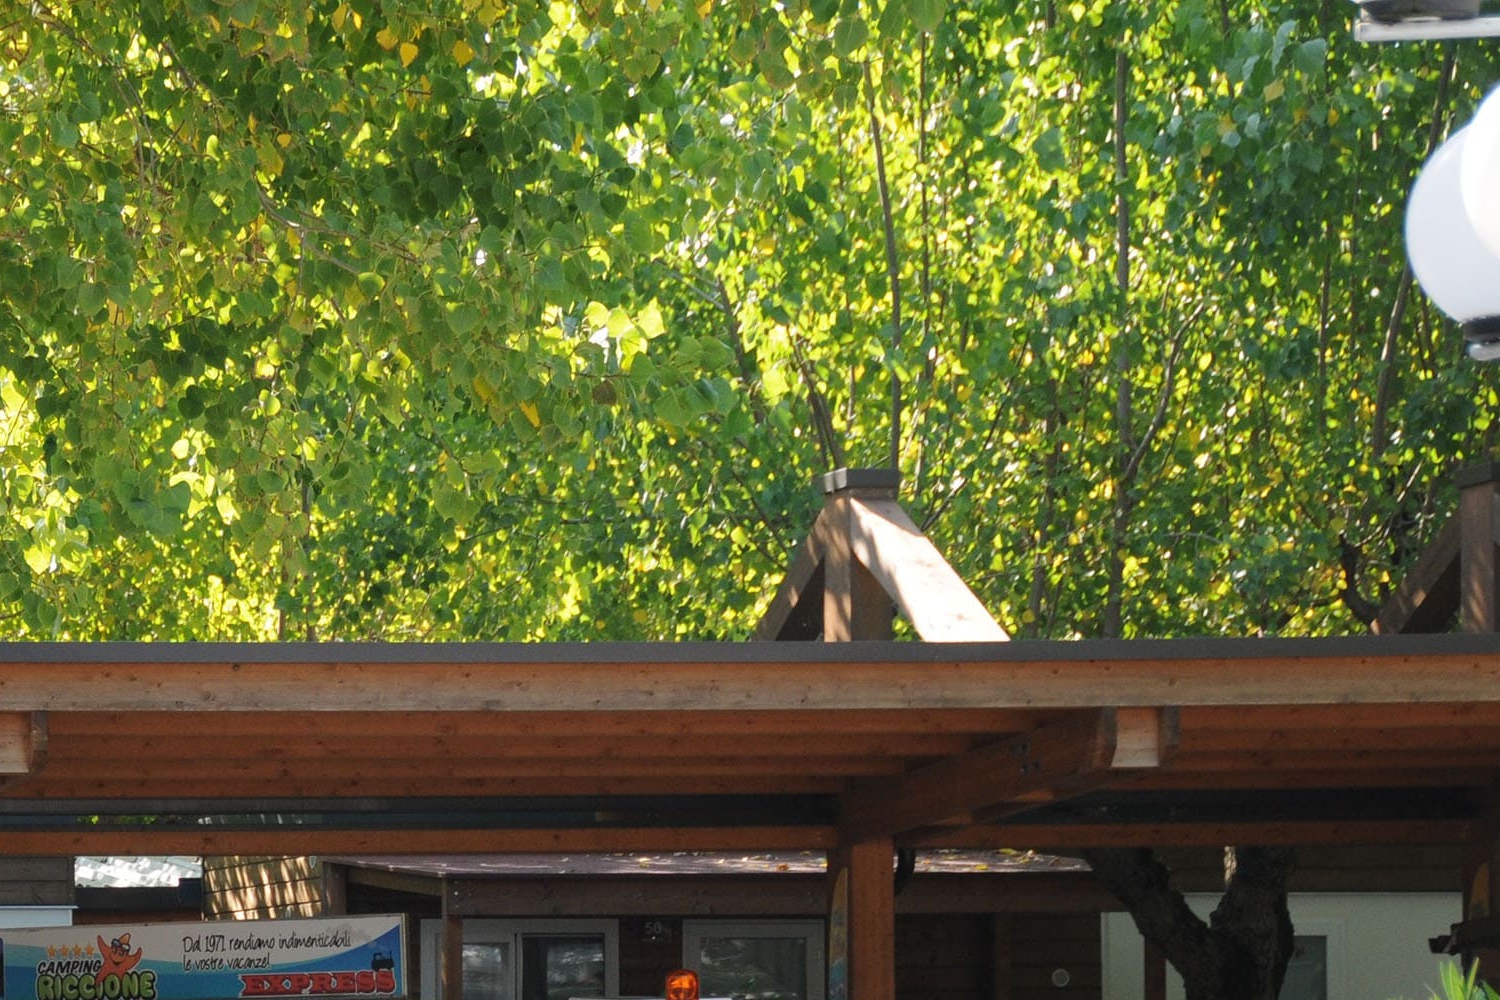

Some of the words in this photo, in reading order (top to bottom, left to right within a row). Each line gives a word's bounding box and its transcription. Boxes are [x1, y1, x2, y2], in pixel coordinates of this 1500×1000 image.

[205, 935, 226, 953] 1971
[229, 932, 275, 950] rendiamo
[278, 930, 351, 949] indimenticabili
[37, 960, 101, 975] CAMPING
[195, 957, 224, 970] vostre
[227, 952, 271, 969] vacanze!
[240, 971, 396, 998] EXPRESS
